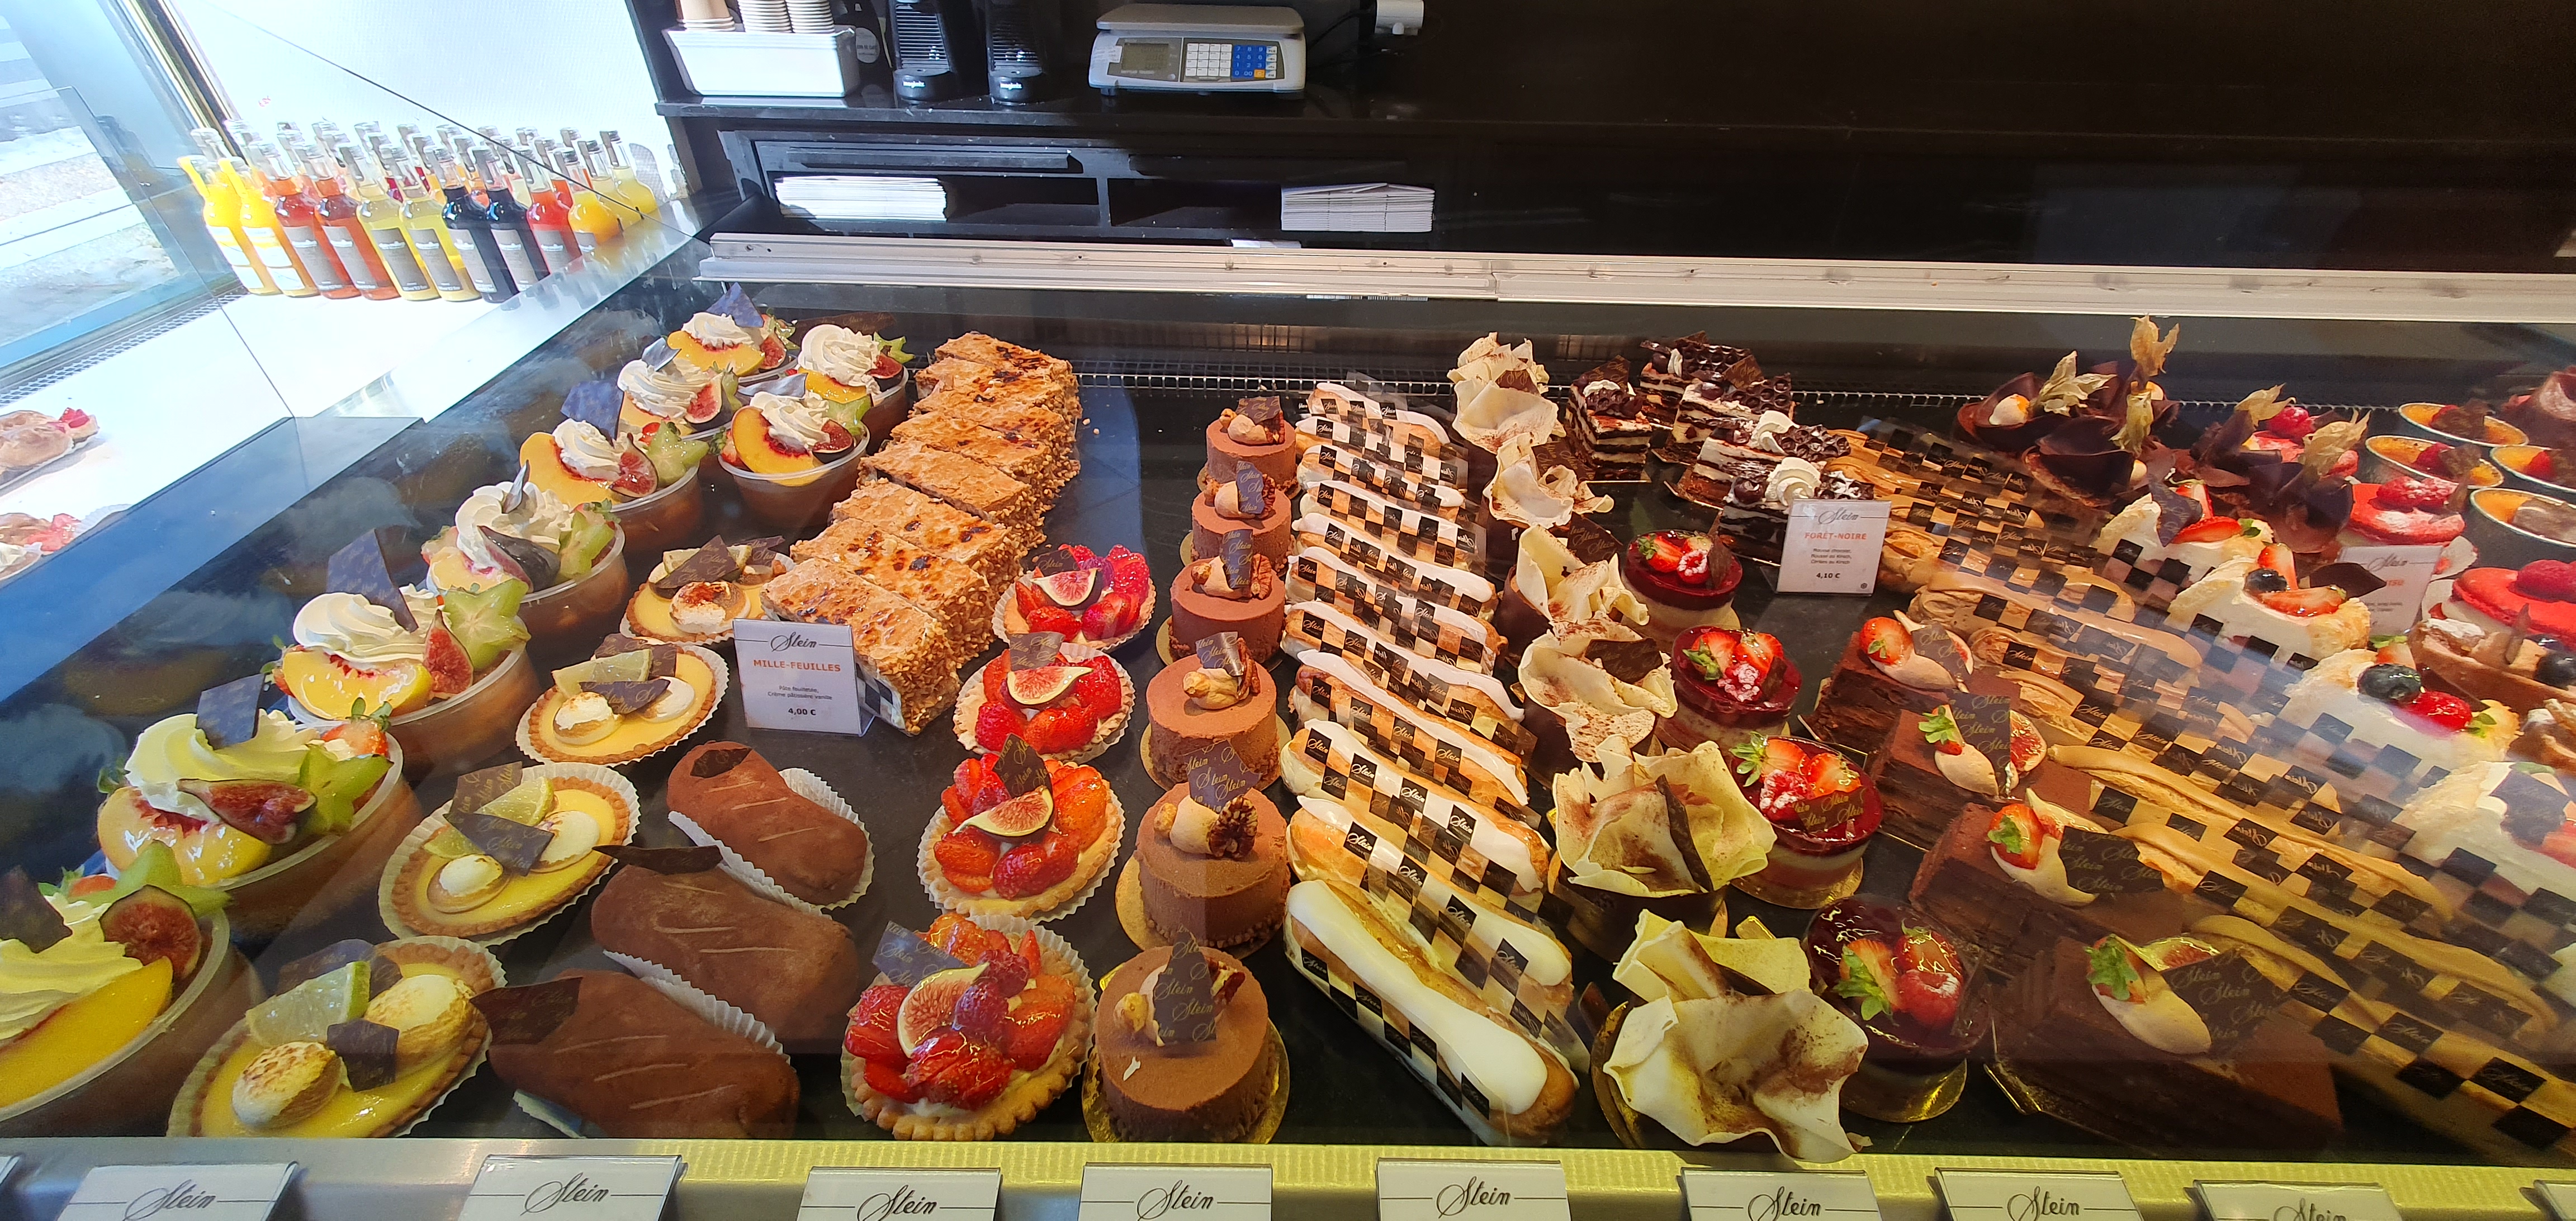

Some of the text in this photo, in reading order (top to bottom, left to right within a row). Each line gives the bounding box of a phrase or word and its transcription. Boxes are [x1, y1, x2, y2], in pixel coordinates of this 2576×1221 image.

[1819, 507, 1859, 524] Stein
[1805, 531, 1867, 540] FORÊT-NOIRE
[1303, 619, 1324, 632] Stein
[770, 632, 817, 652] Stein
[754, 660, 841, 671] MILLE-FEUILLES
[1307, 739, 1329, 754] Stein
[1196, 767, 1228, 789] Stein
[1351, 763, 1375, 779] Stein
[1215, 779, 1246, 801] Stein
[1401, 787, 1426, 803] Stein
[1450, 814, 1474, 834] Stein
[1347, 831, 1373, 852] Stein
[1154, 979, 1194, 1001] Stein
[1172, 999, 1213, 1022] Stein
[122, 1179, 217, 1221] Stein
[520, 1172, 609, 1215] Stein
[857, 1185, 937, 1221] Stein
[1137, 1180, 1214, 1221] Stein
[1436, 1176, 1511, 1219] Stein
[1748, 1186, 1822, 1221] Stein
[2007, 1186, 2080, 1221] Stein
